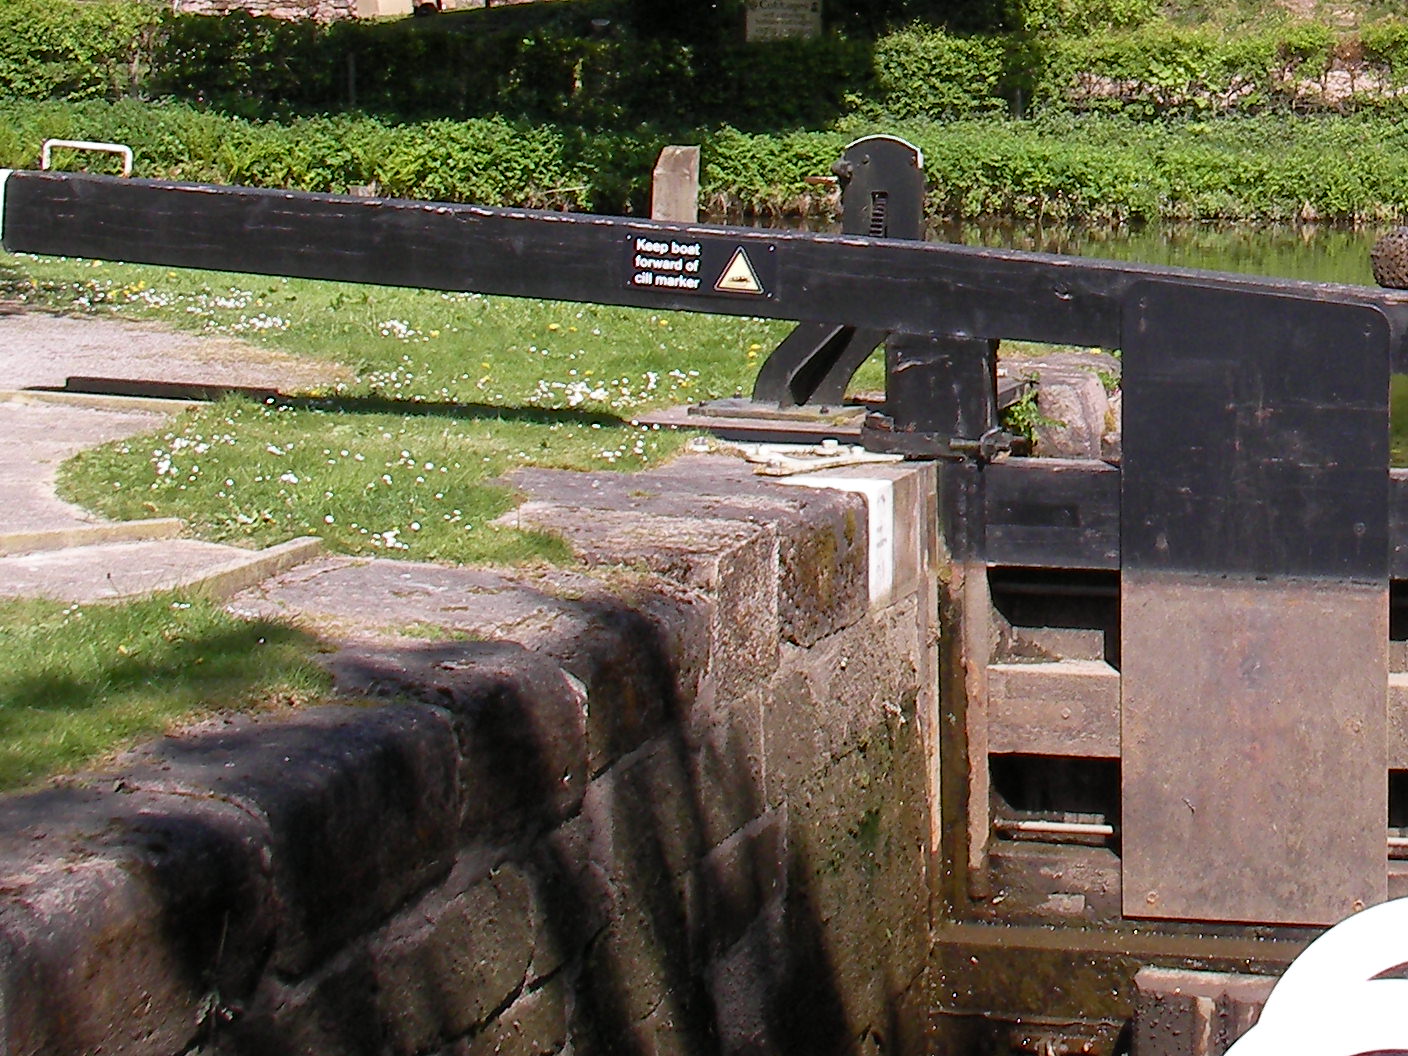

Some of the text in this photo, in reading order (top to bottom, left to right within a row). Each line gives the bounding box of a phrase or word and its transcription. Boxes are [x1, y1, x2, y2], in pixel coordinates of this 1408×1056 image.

[636, 238, 701, 256] Keep boat
[635, 255, 700, 272] forward of
[634, 272, 701, 289] cill marker
